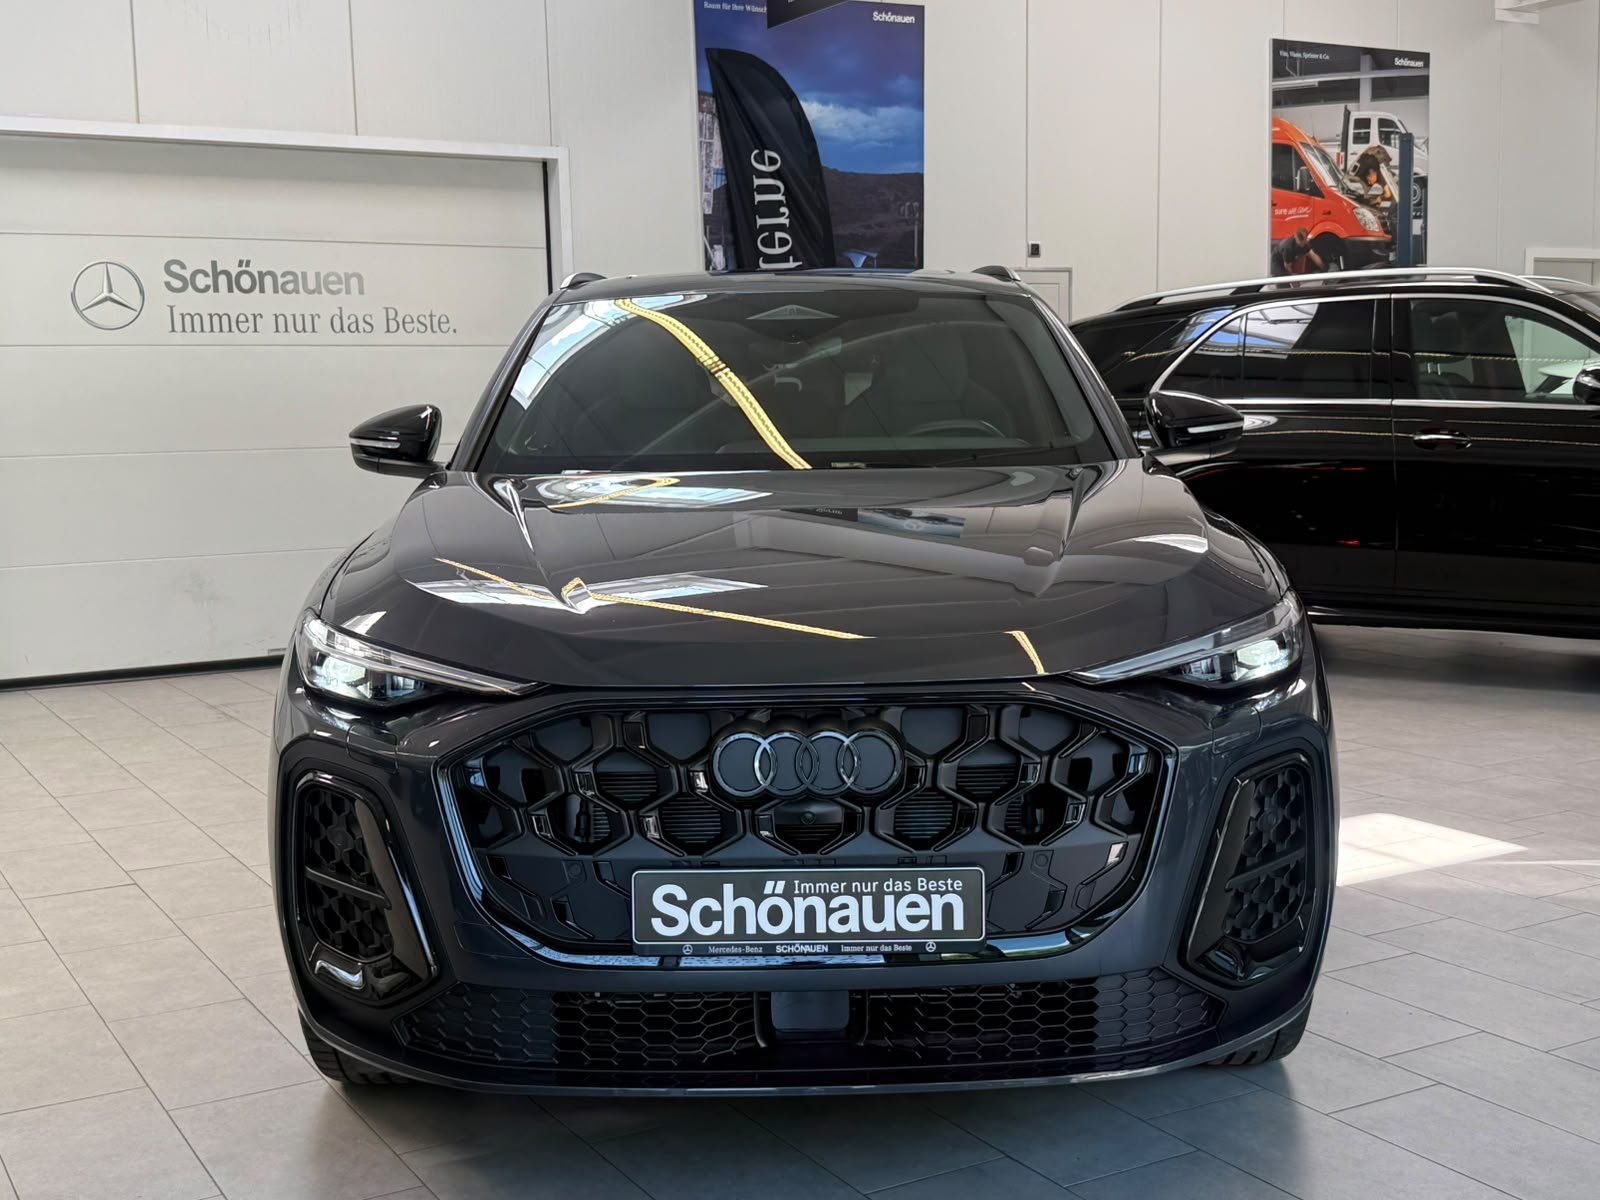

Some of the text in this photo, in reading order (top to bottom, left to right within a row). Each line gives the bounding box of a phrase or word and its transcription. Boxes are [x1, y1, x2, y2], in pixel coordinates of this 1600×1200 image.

[703, 1, 721, 9] Raum
[722, 2, 731, 10] für
[872, 11, 916, 24] Schönauen
[1394, 57, 1424, 68] Schönauen
[163, 258, 365, 295] Schönauen
[166, 304, 457, 335] Immer nur das Beste.
[793, 877, 963, 894] Immer nur das Beste
[651, 880, 964, 937] Schönauen
[708, 945, 763, 953] Mercedes-Benz
[775, 944, 829, 954] SCHÖNAUEN
[840, 944, 864, 952] Immer
